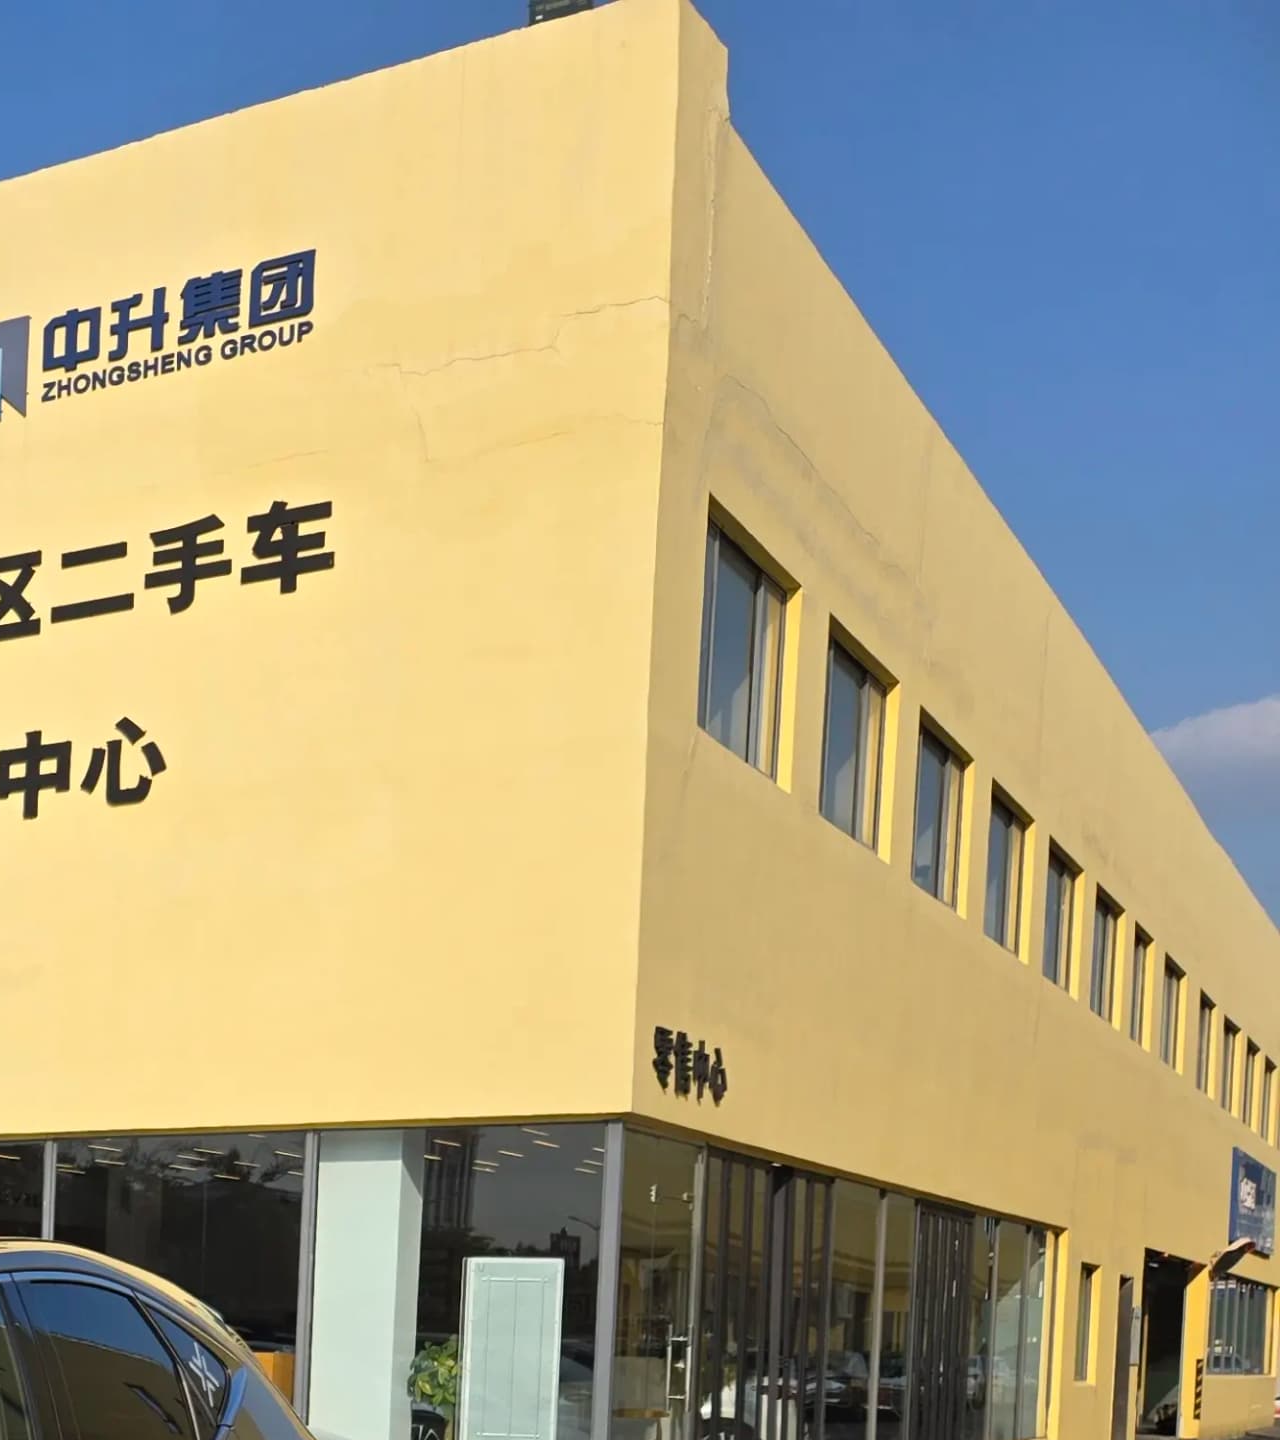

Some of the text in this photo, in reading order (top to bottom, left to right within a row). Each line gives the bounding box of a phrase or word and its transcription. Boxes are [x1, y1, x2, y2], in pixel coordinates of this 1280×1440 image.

[42, 247, 318, 375] 中升集团
[41, 319, 315, 403] ZHONGSHENG GROUP
[652, 1025, 728, 1108] 零售中心
